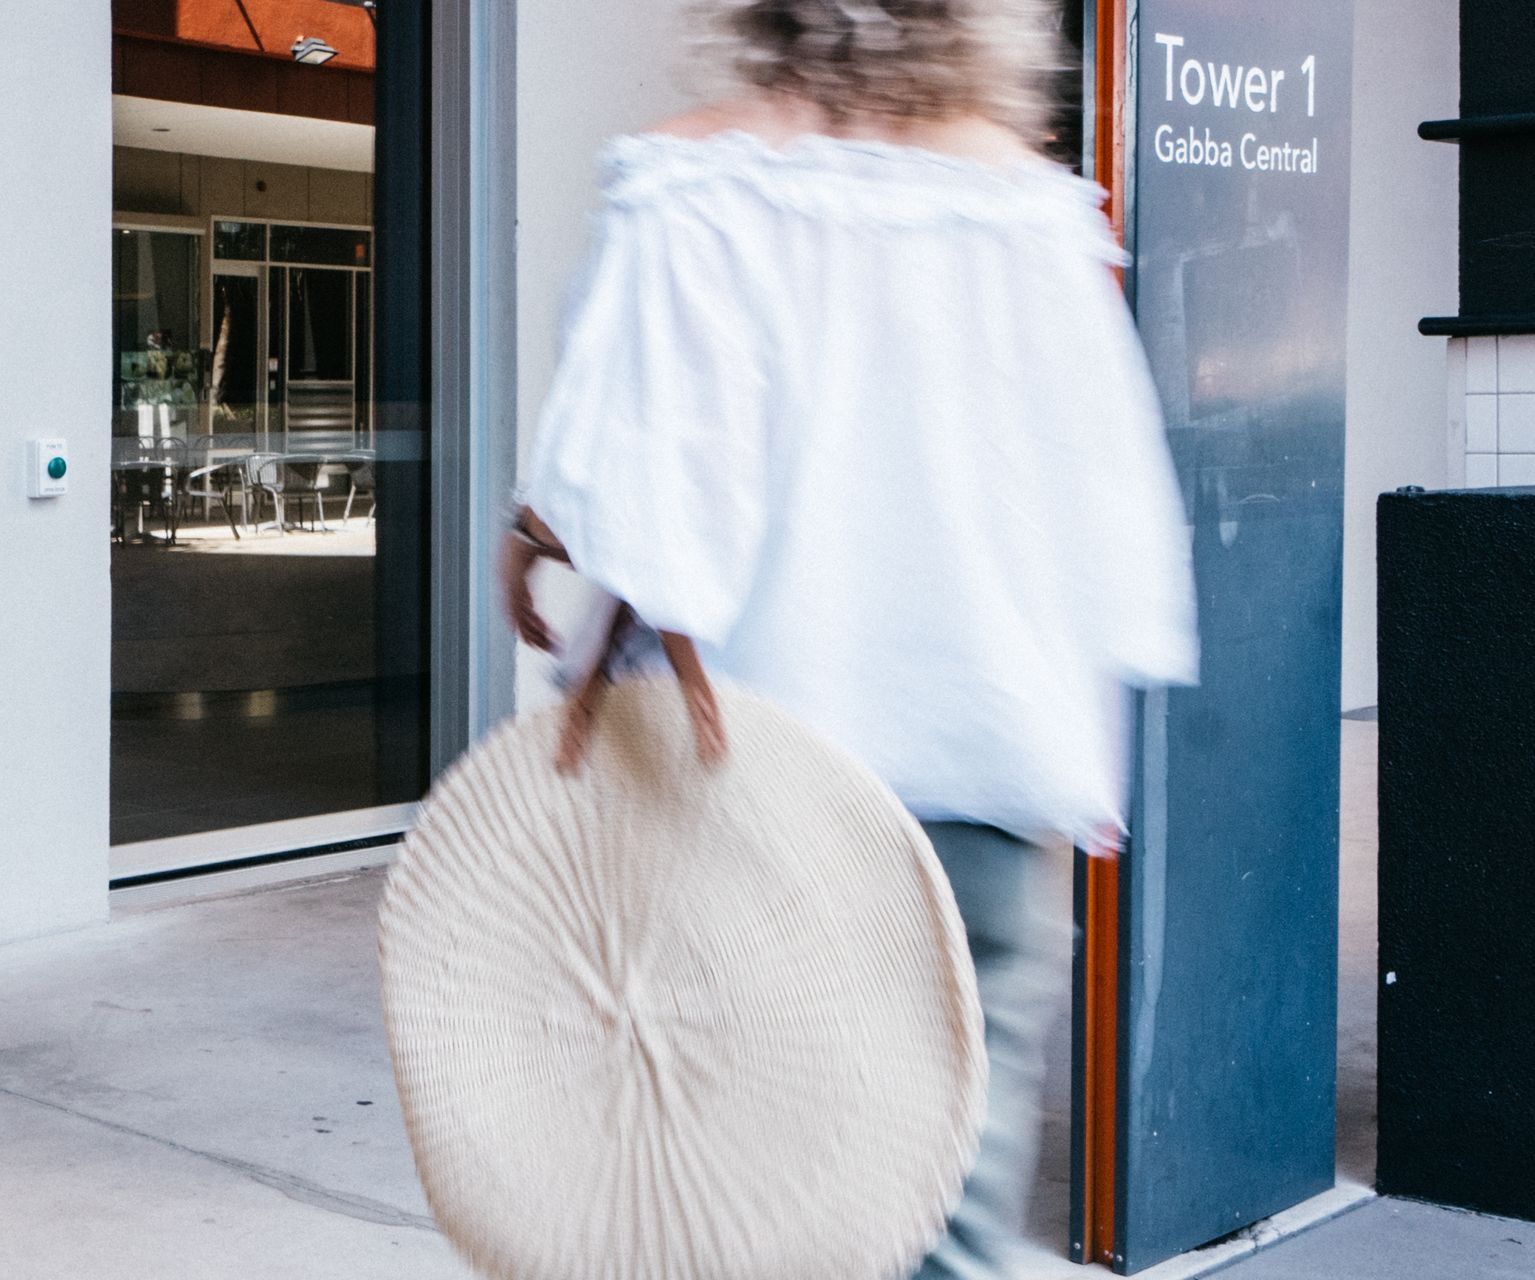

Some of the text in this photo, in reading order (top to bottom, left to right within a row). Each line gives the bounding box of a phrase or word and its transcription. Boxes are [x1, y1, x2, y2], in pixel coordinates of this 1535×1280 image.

[1154, 32, 1316, 117] Tower 1
[1154, 123, 1318, 174] Gabba Central
